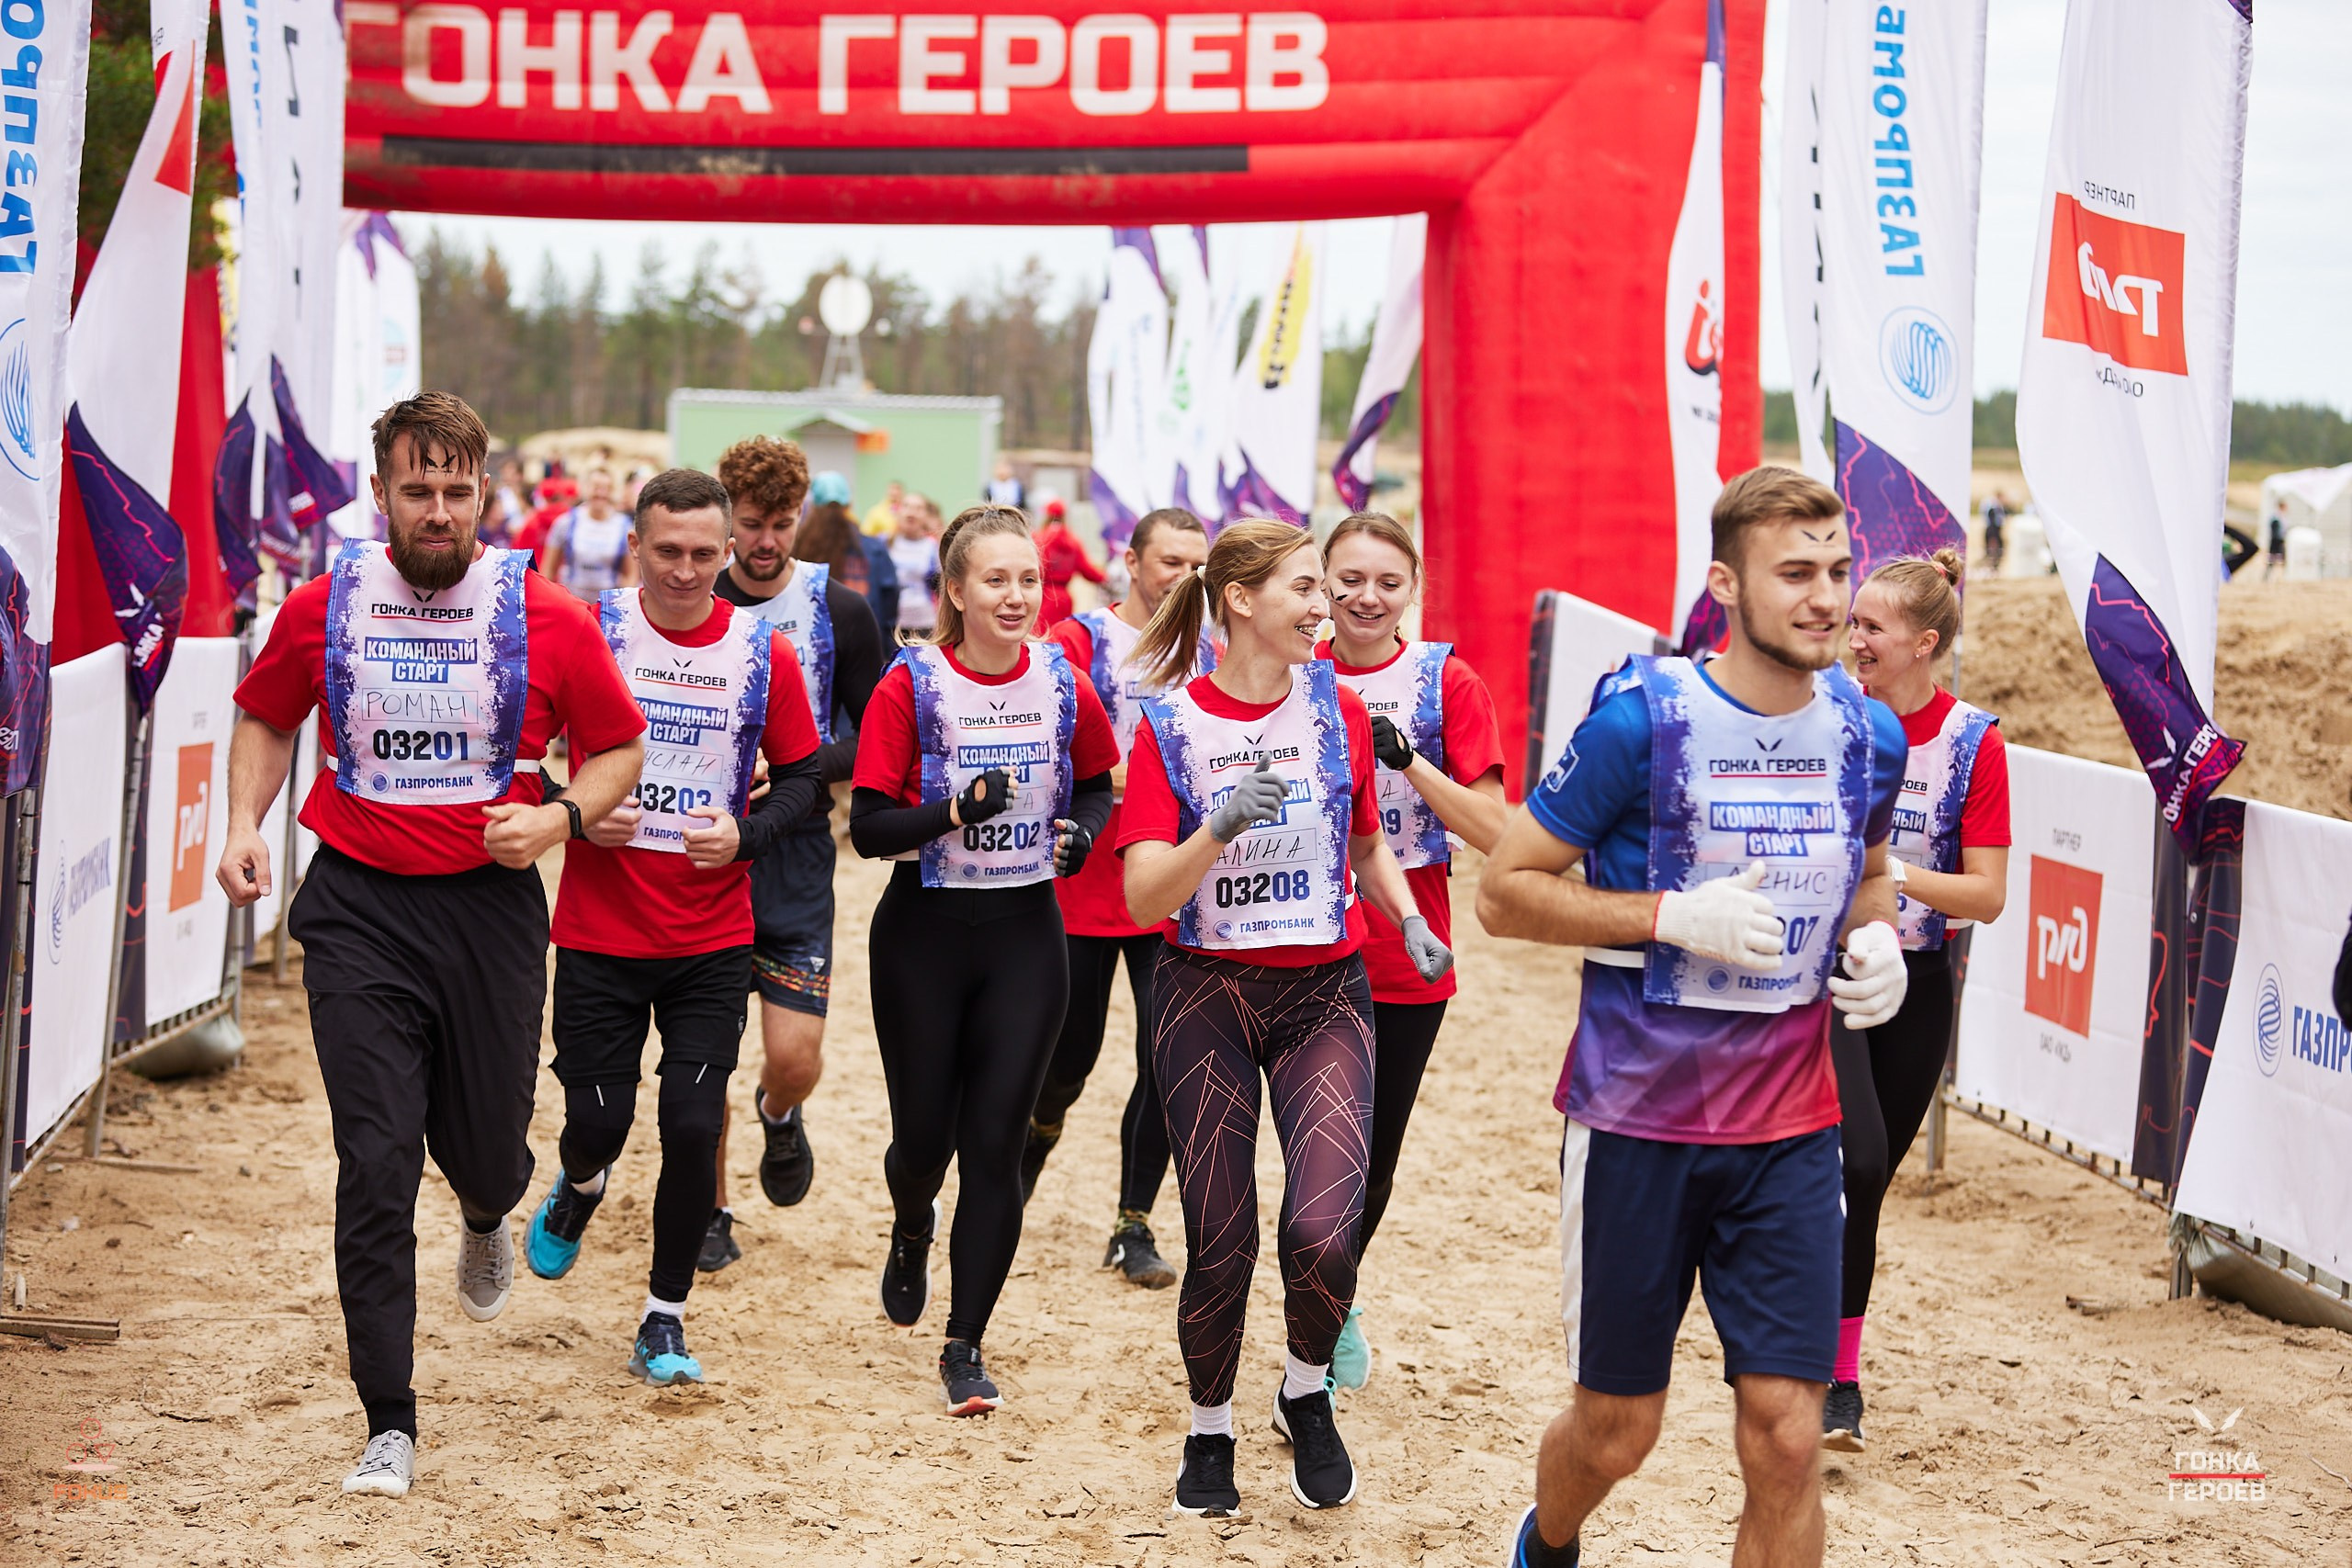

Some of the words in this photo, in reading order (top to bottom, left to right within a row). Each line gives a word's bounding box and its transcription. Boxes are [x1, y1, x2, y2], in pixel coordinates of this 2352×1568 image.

[818, 12, 1329, 116] ГЕРОЕВ
[371, 604, 416, 617] ГОНКА
[421, 607, 474, 620] ГЕРОЕВ
[366, 637, 476, 663] КОМАНДНЫЙ
[394, 662, 446, 682] СТАРТ
[635, 668, 675, 682] ГОНКА
[680, 674, 727, 687] ГЕРОЕВ
[367, 691, 467, 723] РОМАН
[959, 716, 996, 727] ГОНКА
[1000, 713, 1042, 725] ГЕРОЕВ
[373, 729, 469, 761] 03201
[652, 723, 698, 744] СТАРТ
[642, 750, 716, 775] УСЛАН
[959, 740, 1048, 765] КОМАНДНЫЙ
[1210, 751, 1250, 770] ГОНКА
[1709, 760, 1761, 773] ГОНКА
[1767, 758, 1826, 772] ГЕРОЕВ
[395, 776, 473, 789] ГАЗПРОМБАНК
[2163, 769, 2192, 822] ОНКА
[1712, 801, 1834, 832] КОМАНДНЫЙ
[964, 821, 1041, 852] 03202
[1748, 832, 1804, 855] СТАРТ
[985, 862, 1039, 876] ГАЗПРОМБАНК
[1216, 869, 1310, 908] 03208
[1239, 919, 1315, 933] ГАЗПРОМБАНК
[2292, 1004, 2352, 1074] ГАЗПР
